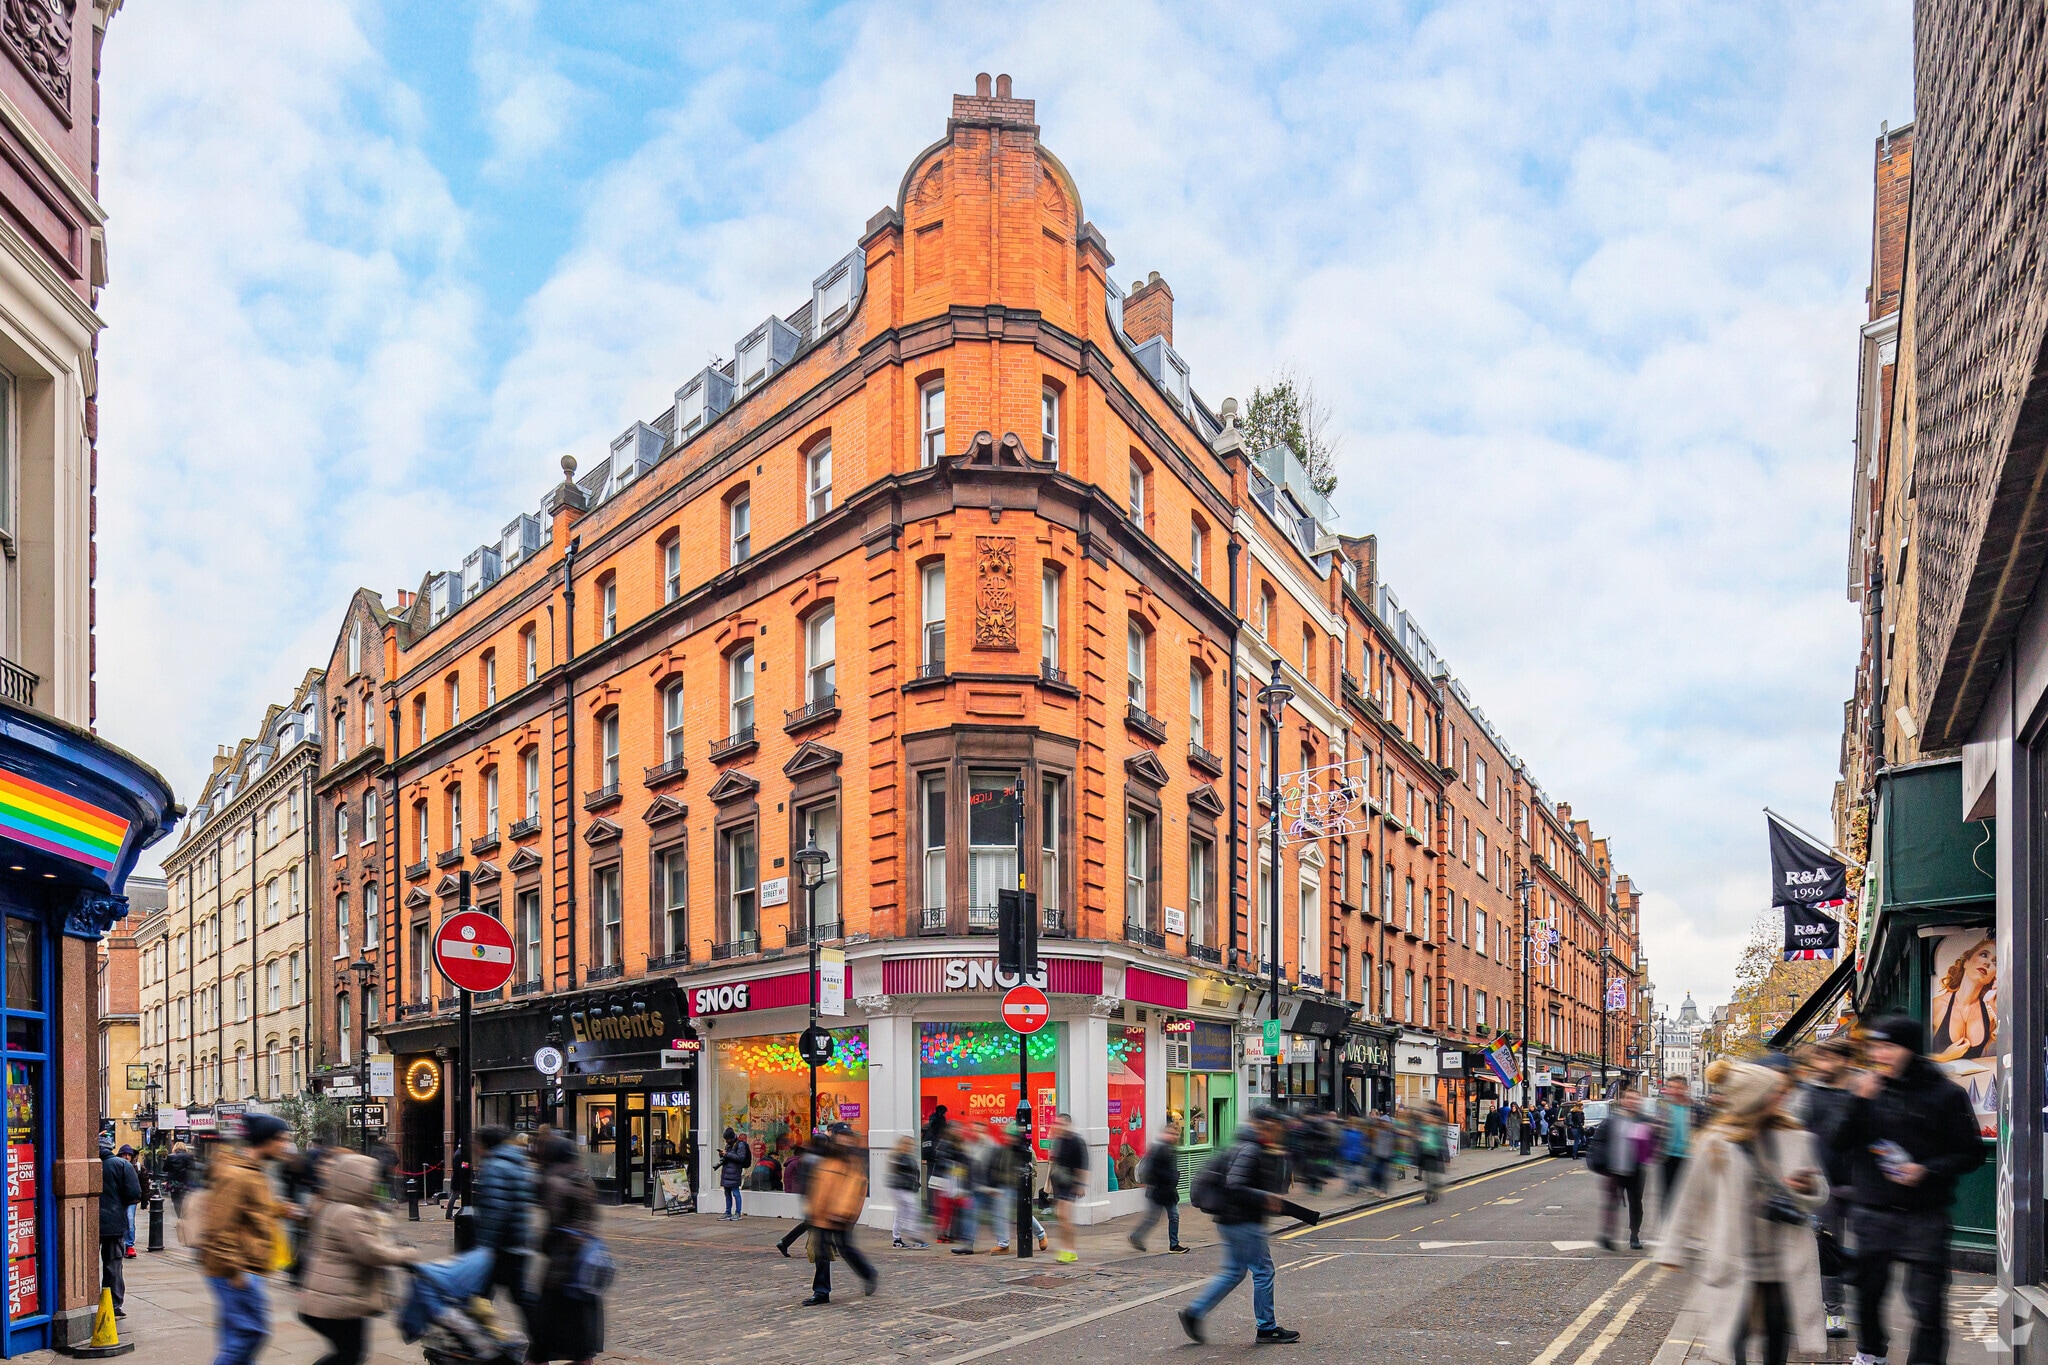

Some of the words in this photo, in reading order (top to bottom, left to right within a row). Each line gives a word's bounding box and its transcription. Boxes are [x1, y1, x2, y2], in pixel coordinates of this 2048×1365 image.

[1785, 868, 1832, 886] R&A
[763, 882, 778, 891] RUPERT
[763, 890, 778, 899] STREET
[779, 888, 785, 896] W1
[1793, 886, 1824, 899] 1996
[1794, 923, 1829, 936] R&A
[1800, 937, 1823, 947] 1996
[946, 960, 1048, 989] SNOG
[695, 984, 748, 1014] SNOG
[570, 1010, 665, 1043] Elements
[1166, 1022, 1191, 1032] SNOG
[677, 1041, 700, 1050] SNOG
[1292, 1043, 1312, 1052] HAI
[1502, 1048, 1517, 1073] SPLASH
[969, 1093, 1006, 1108] SNOG
[191, 1117, 215, 1127] MASSAGE
[990, 1116, 1014, 1124] SNOG
[7, 1148, 19, 1197] SALE!
[19, 1163, 33, 1171] NOW
[19, 1169, 34, 1179] ON!
[19, 1219, 34, 1228] NOW
[8, 1205, 19, 1255] SALE!
[19, 1226, 34, 1235] ON!
[20, 1277, 35, 1287] NOW
[9, 1265, 20, 1315] SALE!
[20, 1284, 36, 1295] ON!
